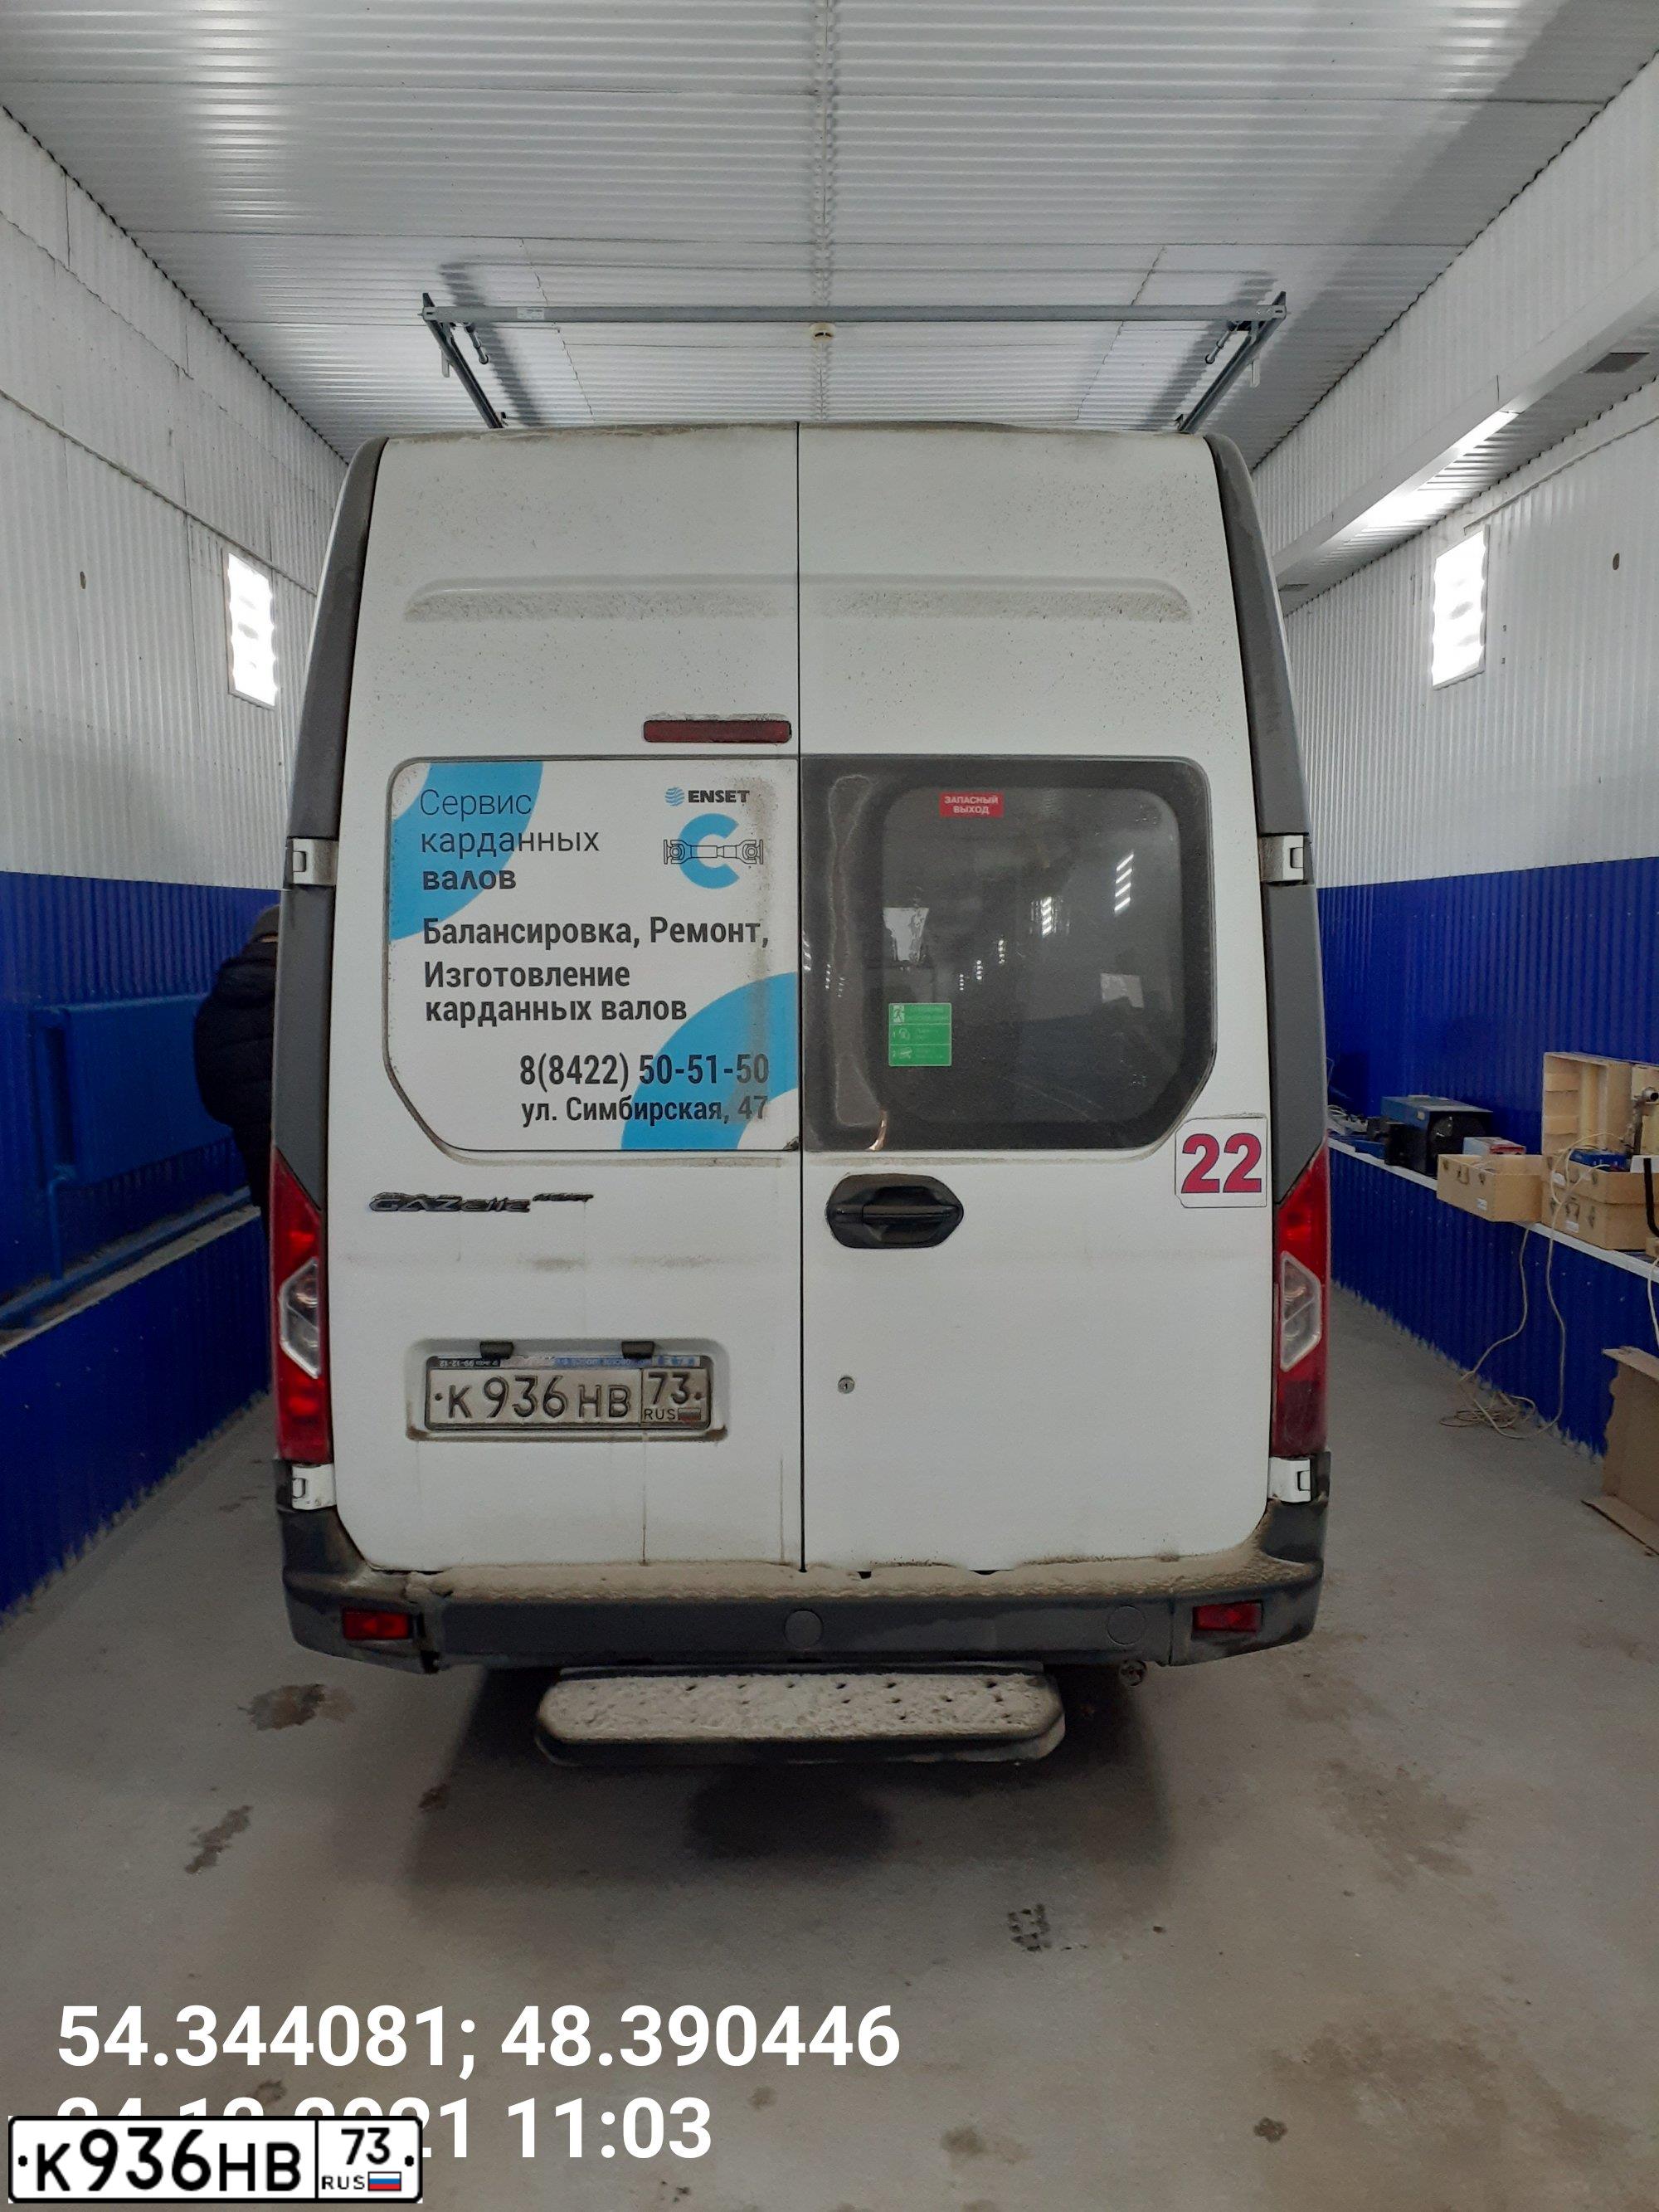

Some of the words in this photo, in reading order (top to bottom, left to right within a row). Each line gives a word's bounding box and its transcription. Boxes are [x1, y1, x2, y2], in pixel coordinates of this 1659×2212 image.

[421, 789, 532, 821] Сервис
[688, 790, 749, 803] ENSET
[944, 794, 999, 806] ЗАПАСНЫЙ
[953, 805, 990, 815] ВЫХОД
[421, 831, 600, 858] карданных
[422, 869, 516, 889] валов
[423, 918, 640, 950] Балансировка,
[650, 917, 769, 948] Ремонт,
[425, 962, 630, 987] Изготовление
[426, 1001, 591, 1028] карданных
[601, 1001, 687, 1021] валов
[520, 1054, 630, 1092] 8(8422)
[640, 1055, 770, 1084] 50-51-50
[521, 1102, 557, 1128] ул.
[567, 1098, 730, 1126] Симбирская,
[737, 1095, 768, 1120] 47
[1181, 1133, 1262, 1193] 22
[649, 1373, 691, 1405] 73
[644, 1409, 675, 1420] RUS
